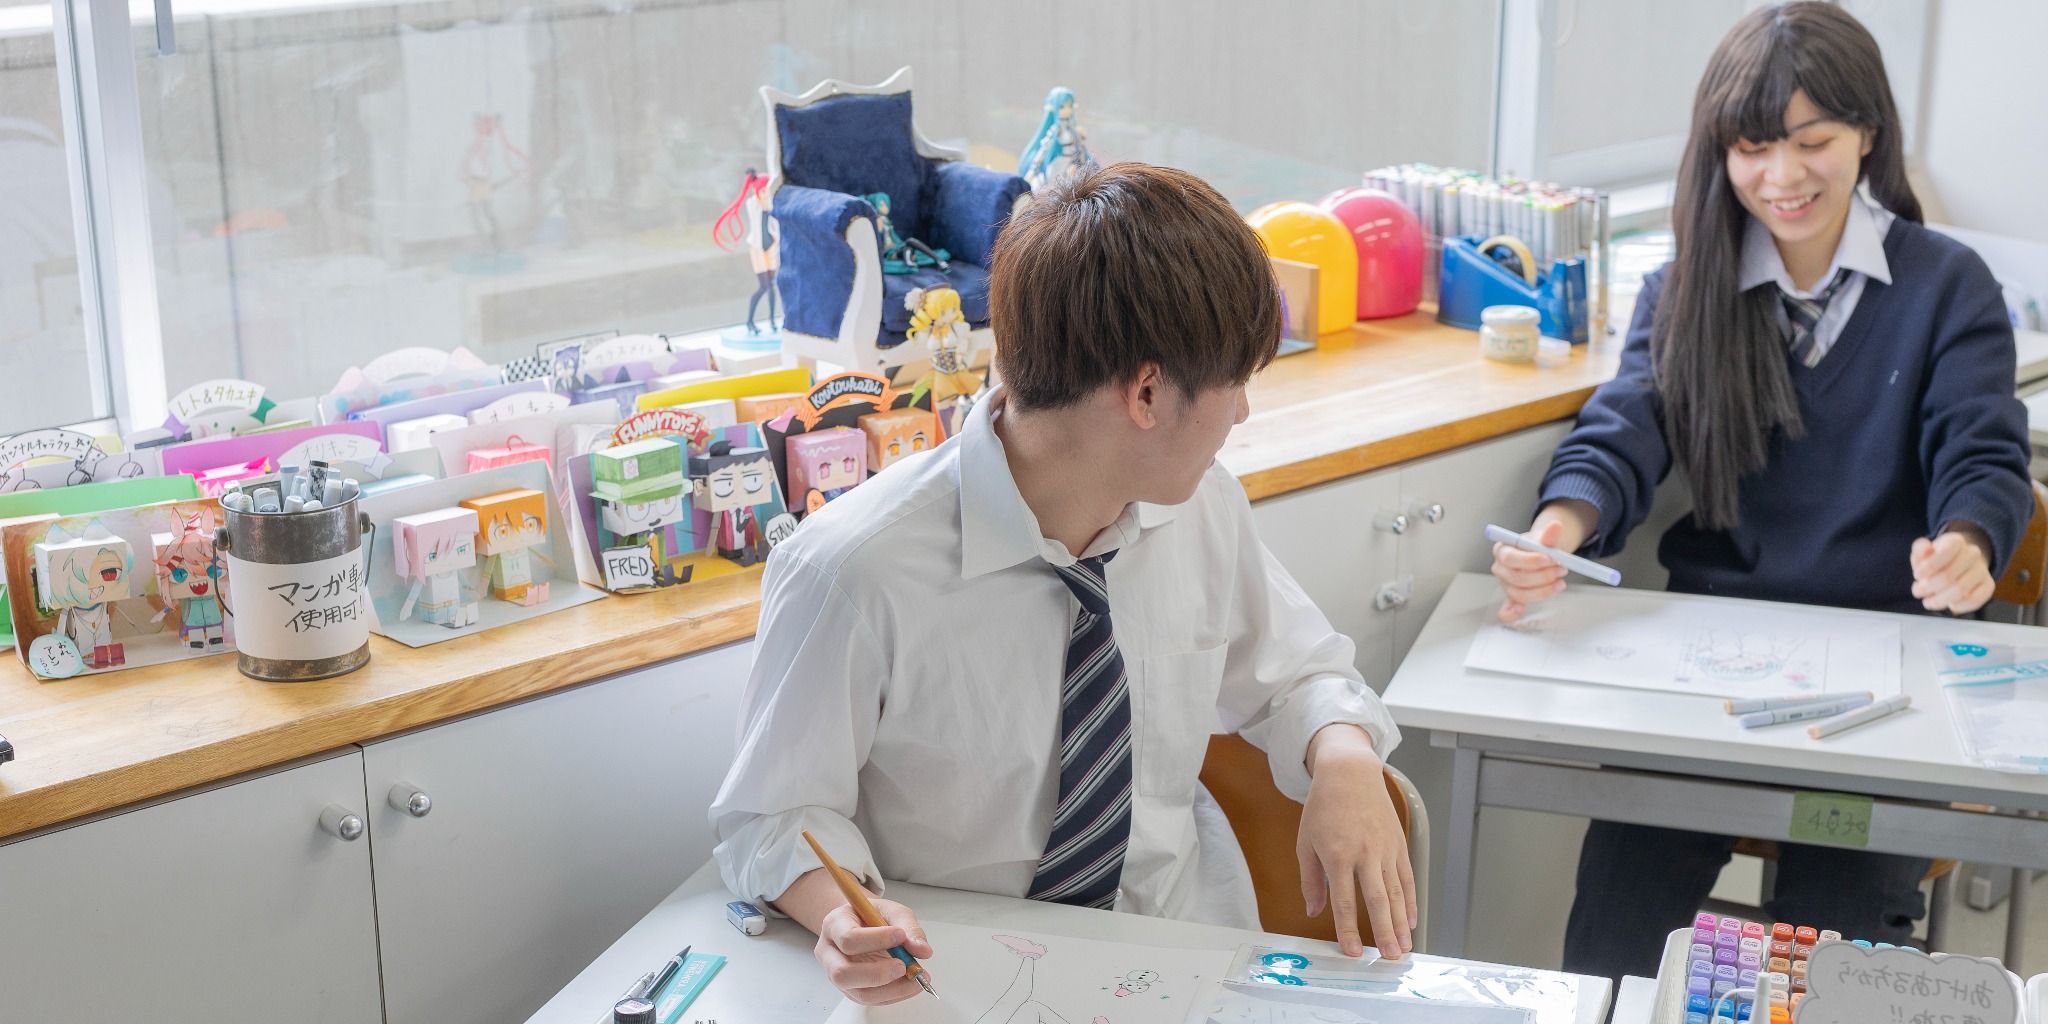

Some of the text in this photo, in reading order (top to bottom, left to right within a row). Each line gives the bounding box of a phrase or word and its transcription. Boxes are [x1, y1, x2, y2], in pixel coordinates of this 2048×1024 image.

[0, 437, 84, 468] リジナルキャラクター
[608, 555, 649, 581] FRED
